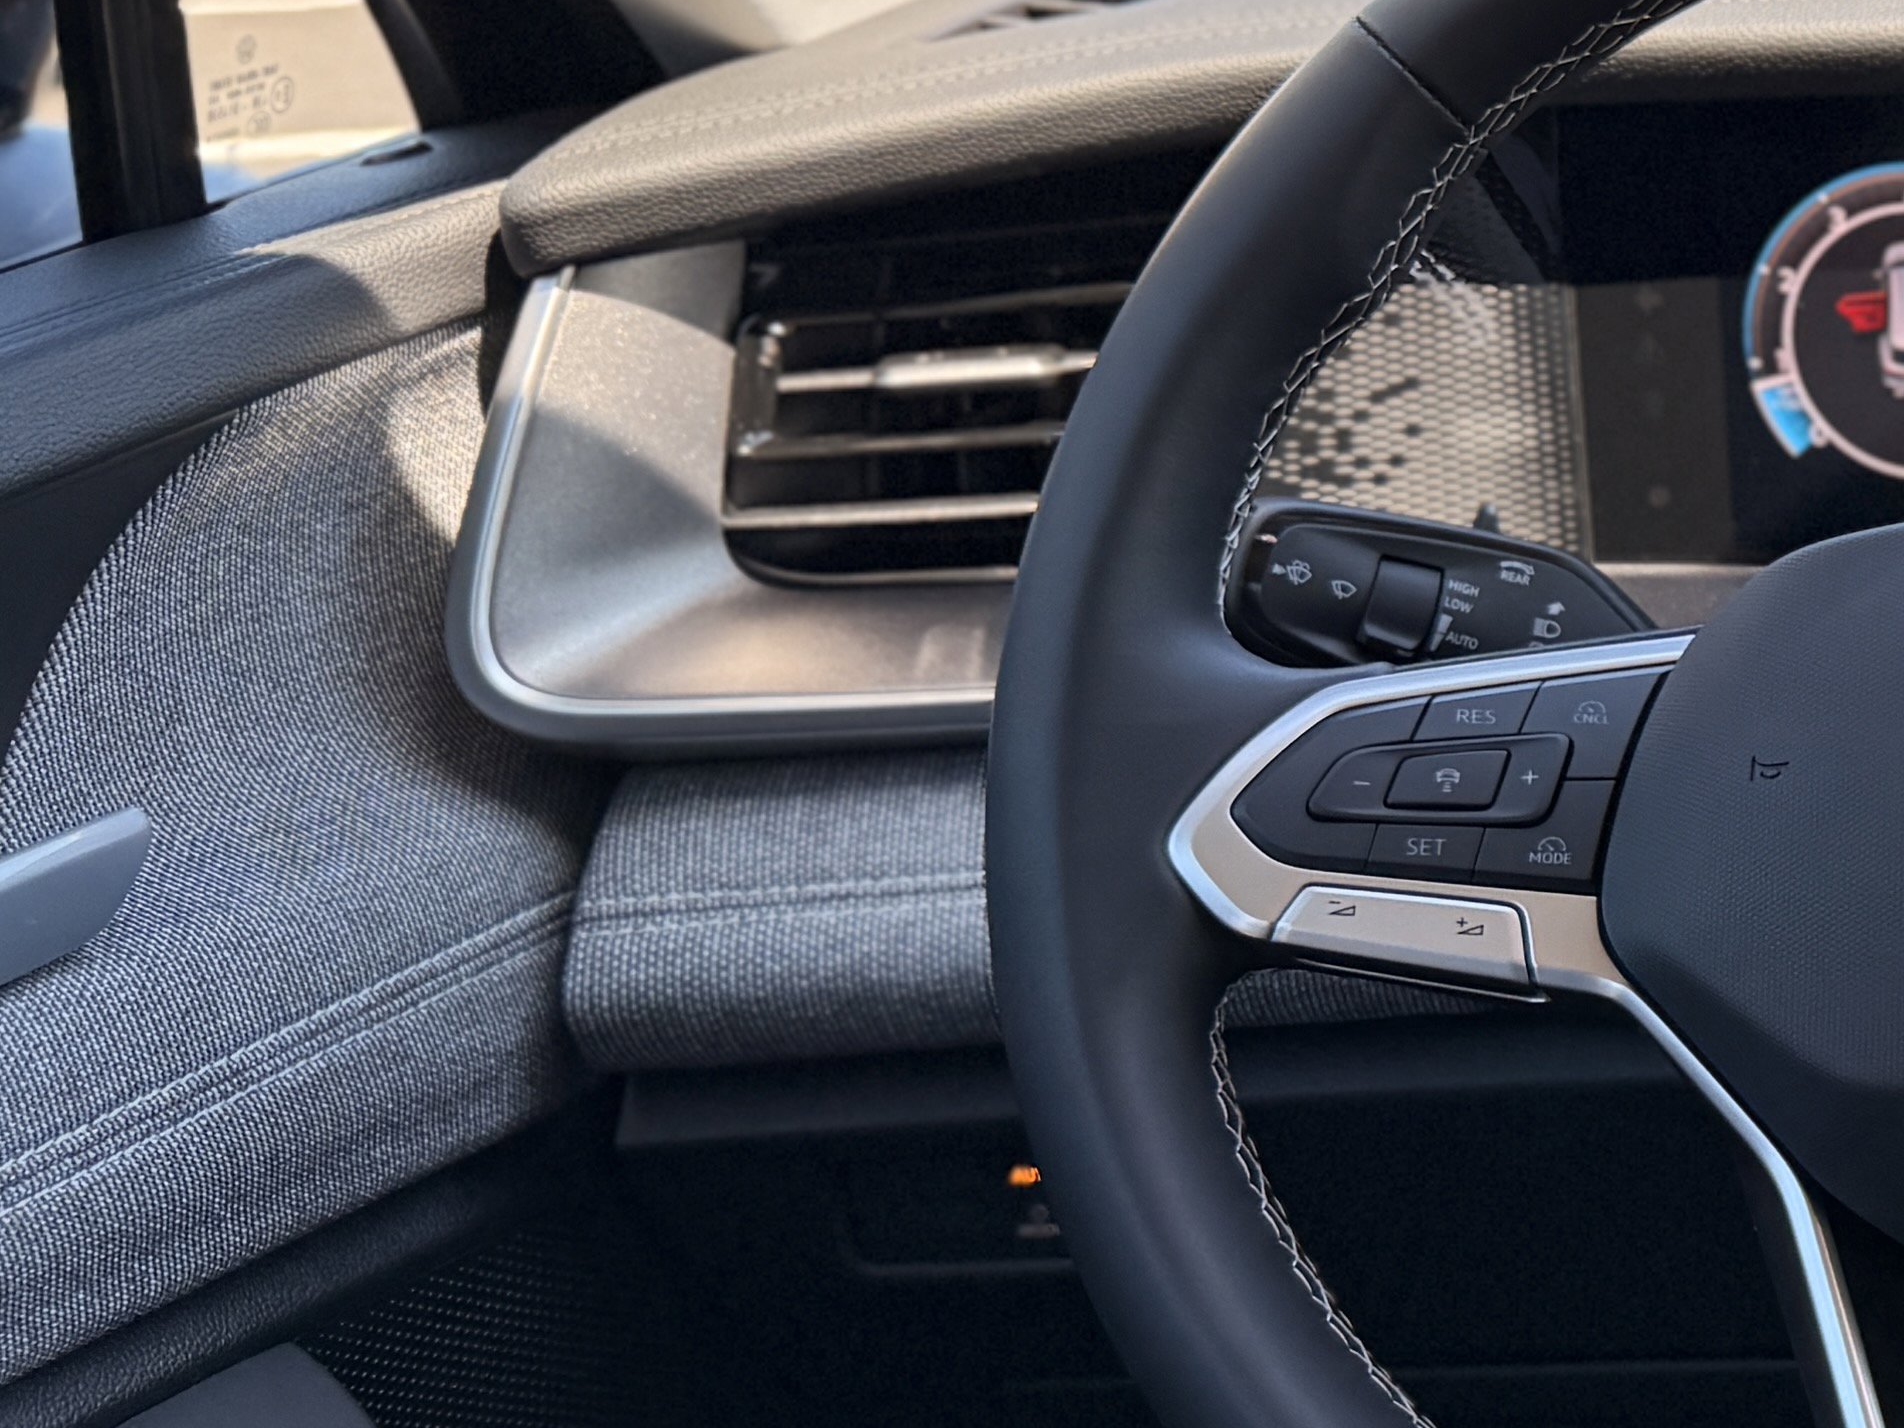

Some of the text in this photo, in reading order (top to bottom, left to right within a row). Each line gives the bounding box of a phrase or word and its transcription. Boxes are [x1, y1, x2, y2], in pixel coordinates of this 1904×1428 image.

[1500, 568, 1533, 587] REAR
[1448, 579, 1481, 599] HIGH
[1444, 596, 1474, 614] LOW
[1445, 630, 1480, 651] AUTO
[1455, 707, 1497, 726] RES
[1572, 711, 1610, 726] CNCL
[1405, 837, 1447, 857] SET
[1528, 849, 1573, 866] MODE
